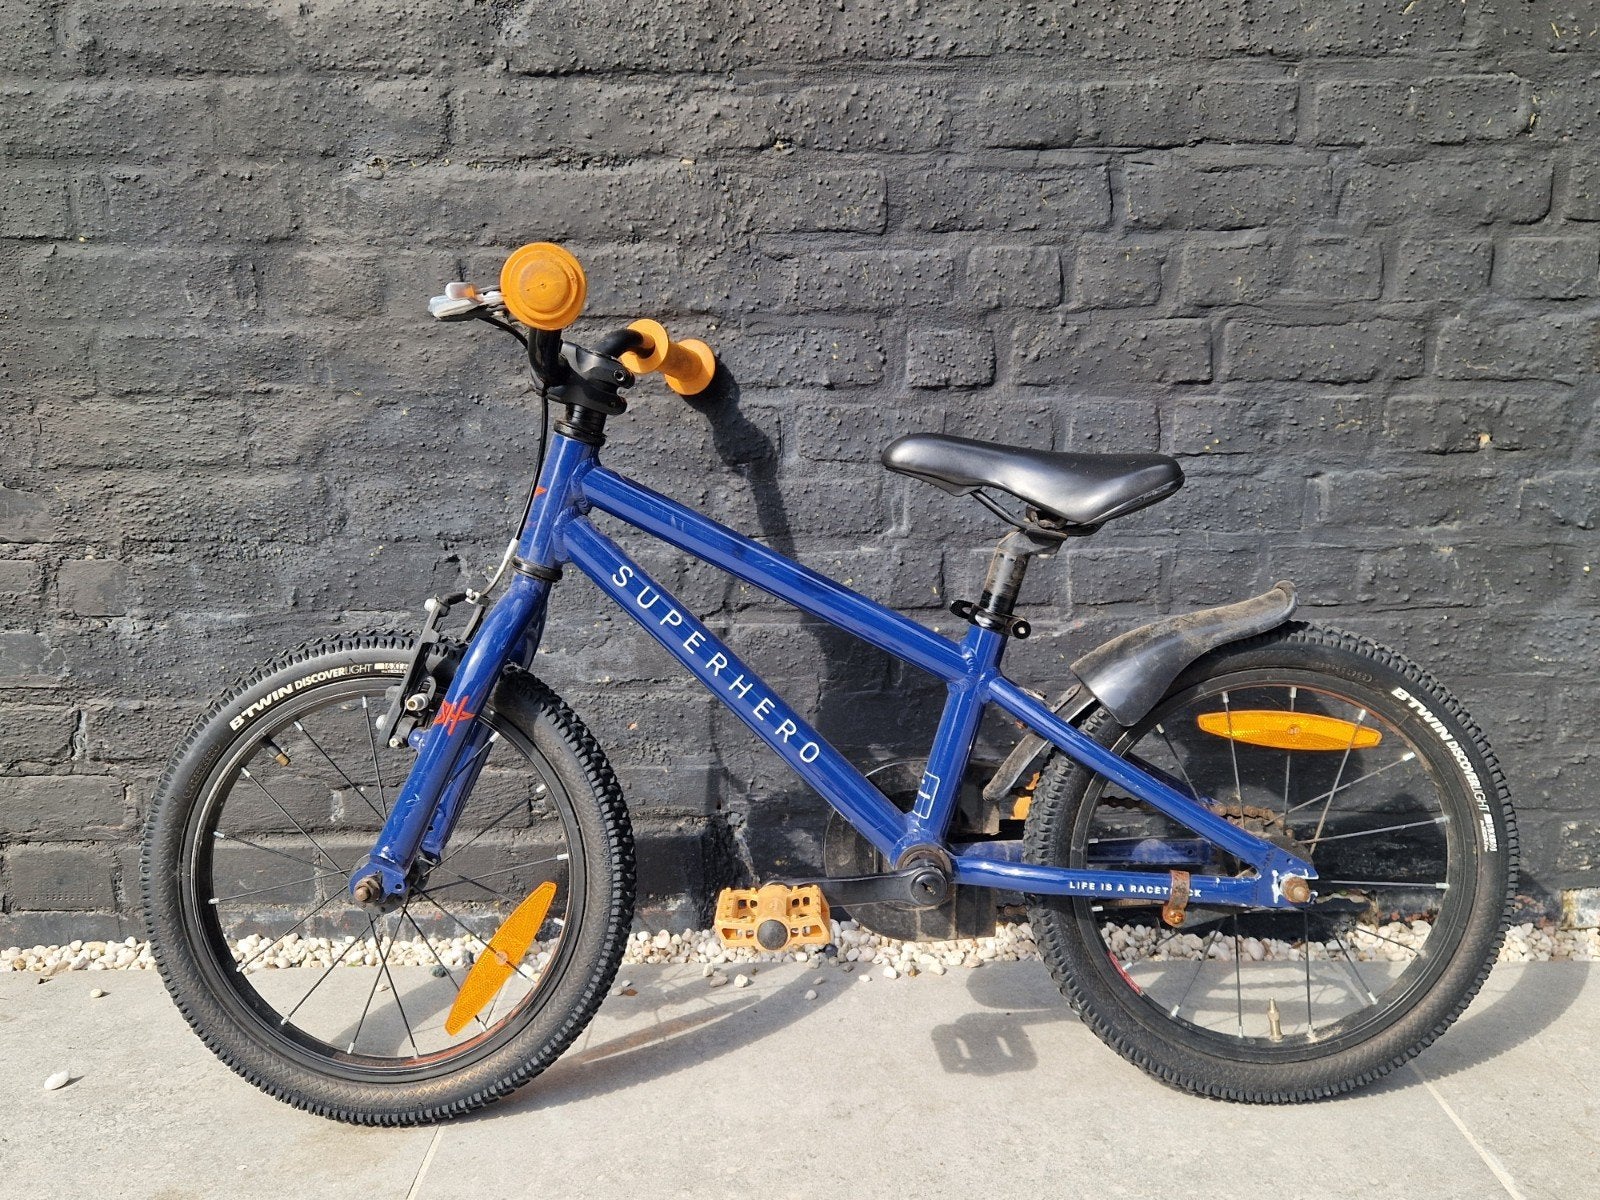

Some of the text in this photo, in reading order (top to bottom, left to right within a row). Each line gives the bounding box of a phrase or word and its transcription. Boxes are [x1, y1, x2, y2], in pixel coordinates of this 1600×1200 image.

[612, 565, 820, 763] SUPERHERO
[1069, 881, 1202, 898] LIFE IS A RACETCK
